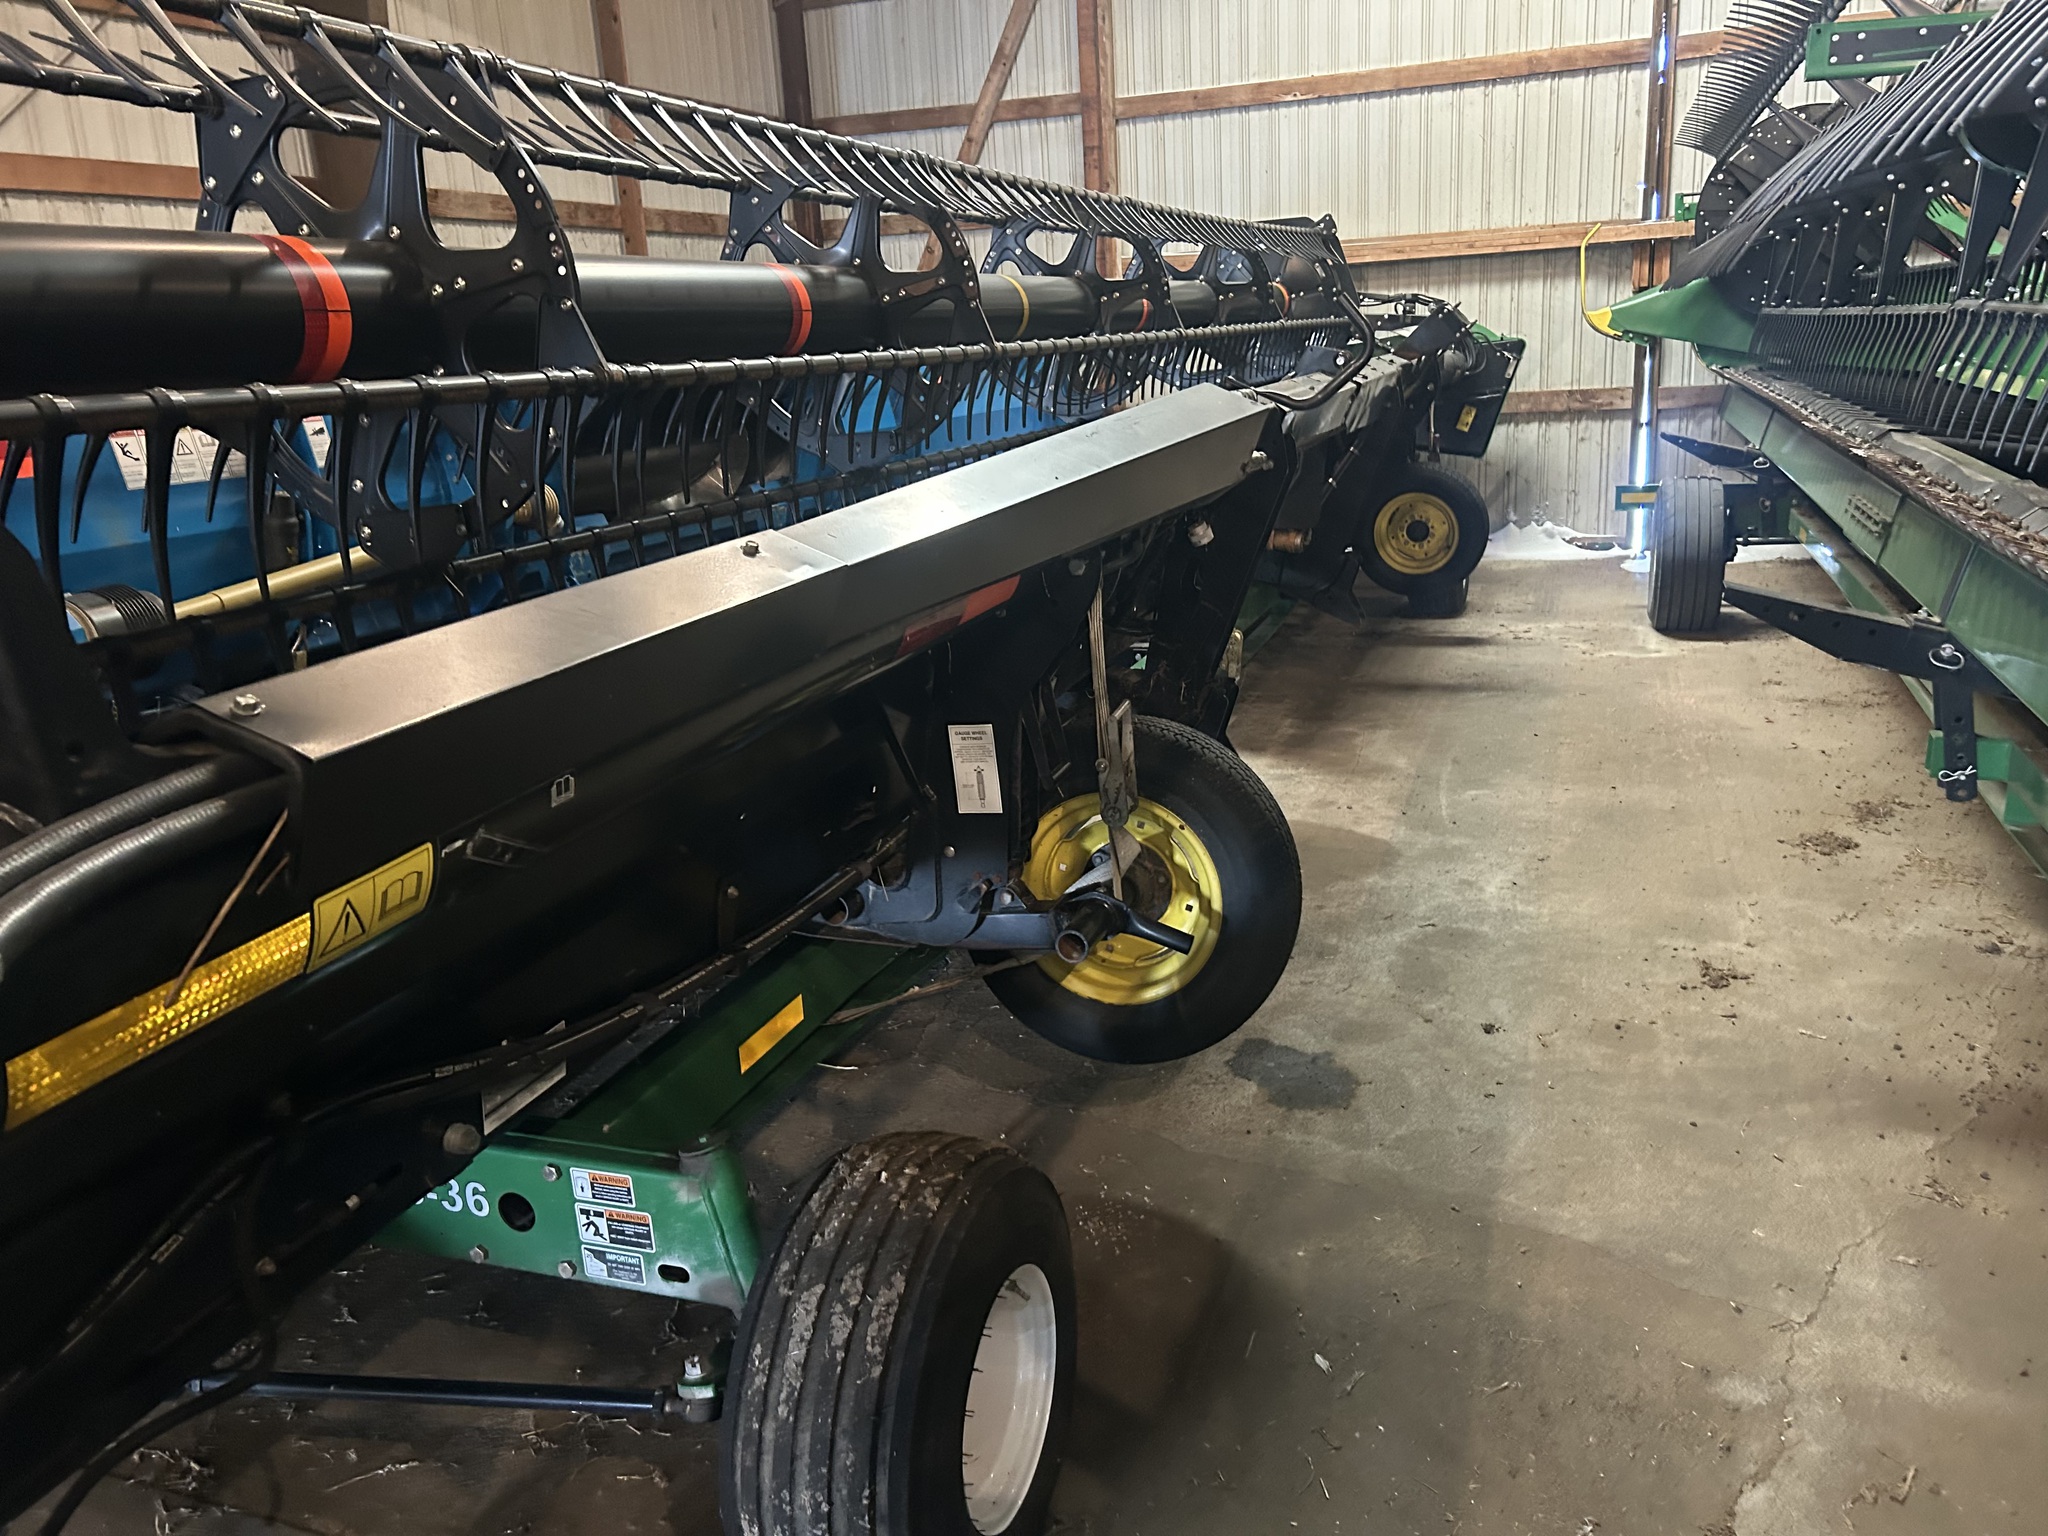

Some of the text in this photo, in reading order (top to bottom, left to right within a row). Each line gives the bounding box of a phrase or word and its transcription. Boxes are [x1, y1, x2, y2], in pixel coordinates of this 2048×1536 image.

[598, 1174, 629, 1186] WARNING
[415, 1178, 490, 1217] -36
[615, 1213, 647, 1223] WARNING
[605, 1252, 640, 1265] IMPORTANT
